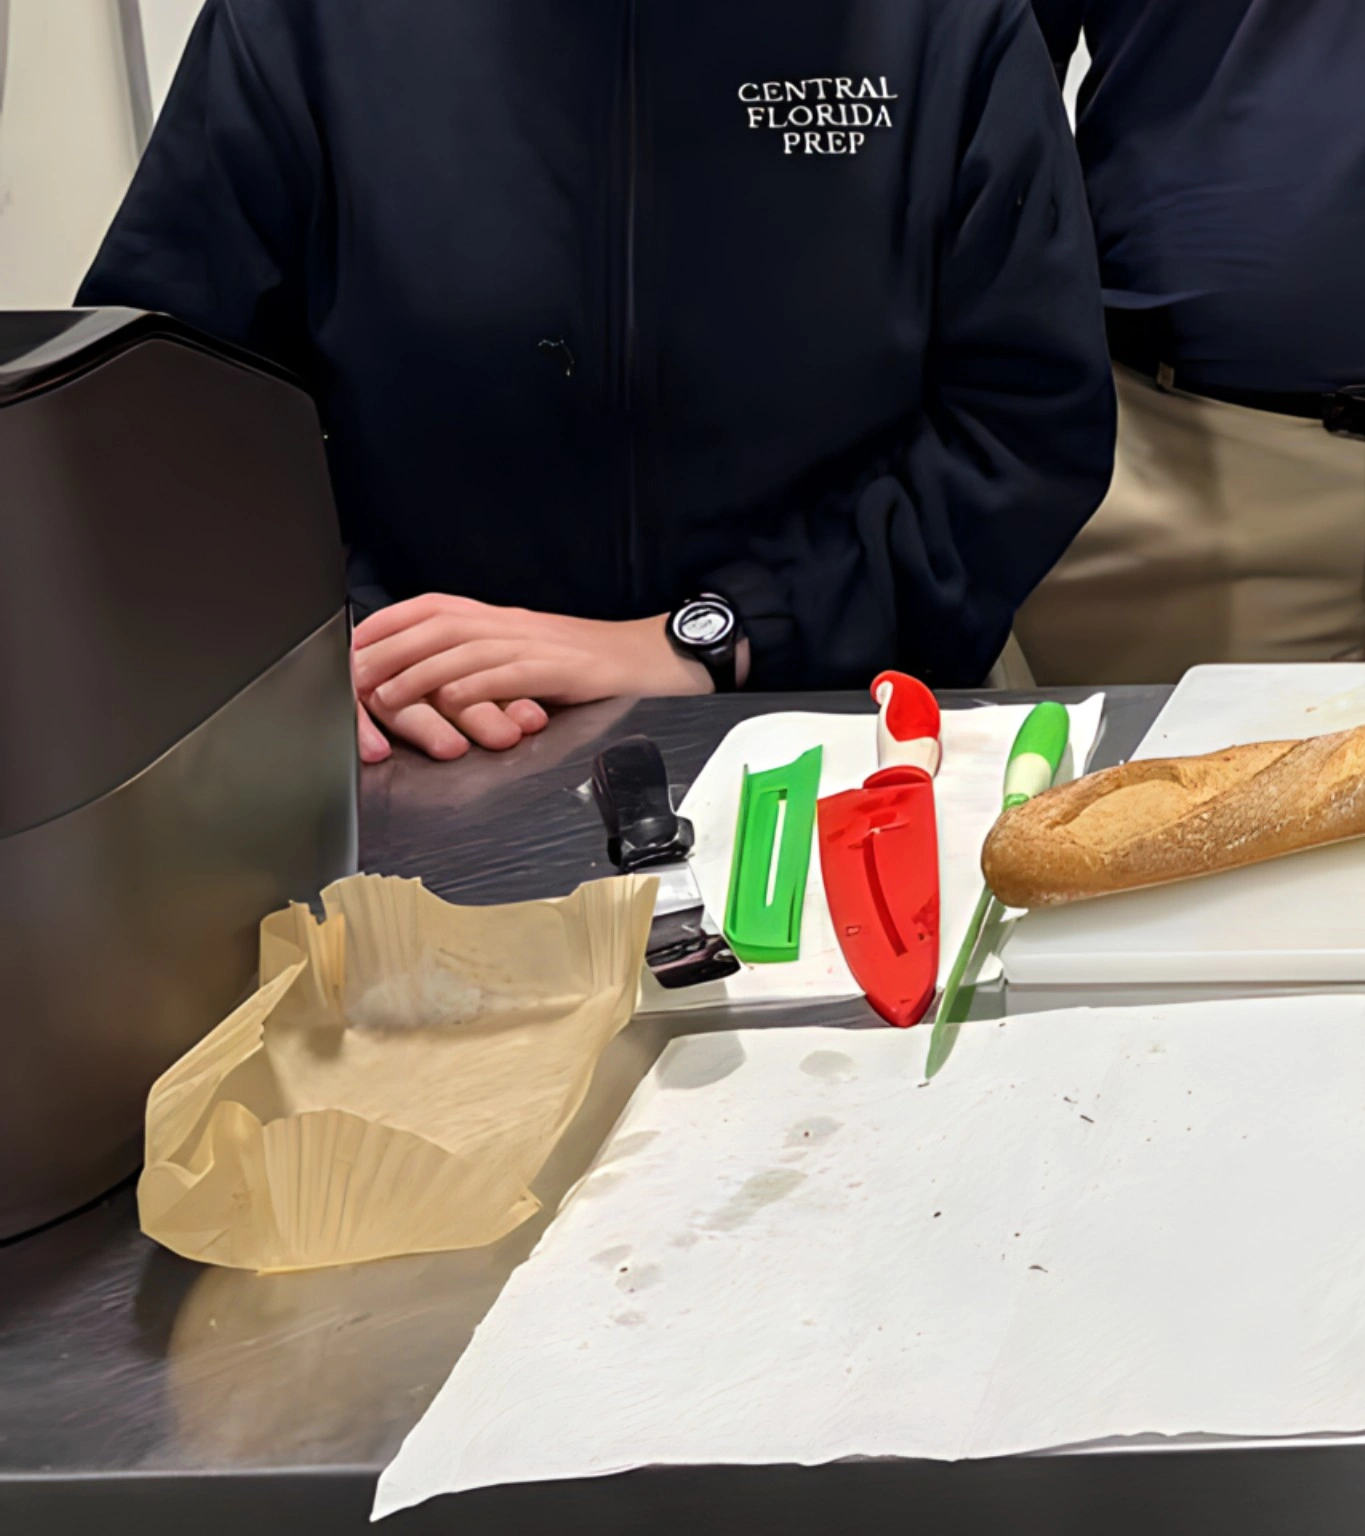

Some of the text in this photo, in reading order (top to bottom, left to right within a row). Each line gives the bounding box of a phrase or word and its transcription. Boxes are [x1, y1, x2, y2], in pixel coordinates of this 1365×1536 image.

[738, 76, 898, 102] CENTRAL
[747, 103, 893, 128] FLORIDA
[783, 131, 865, 155] PREP
